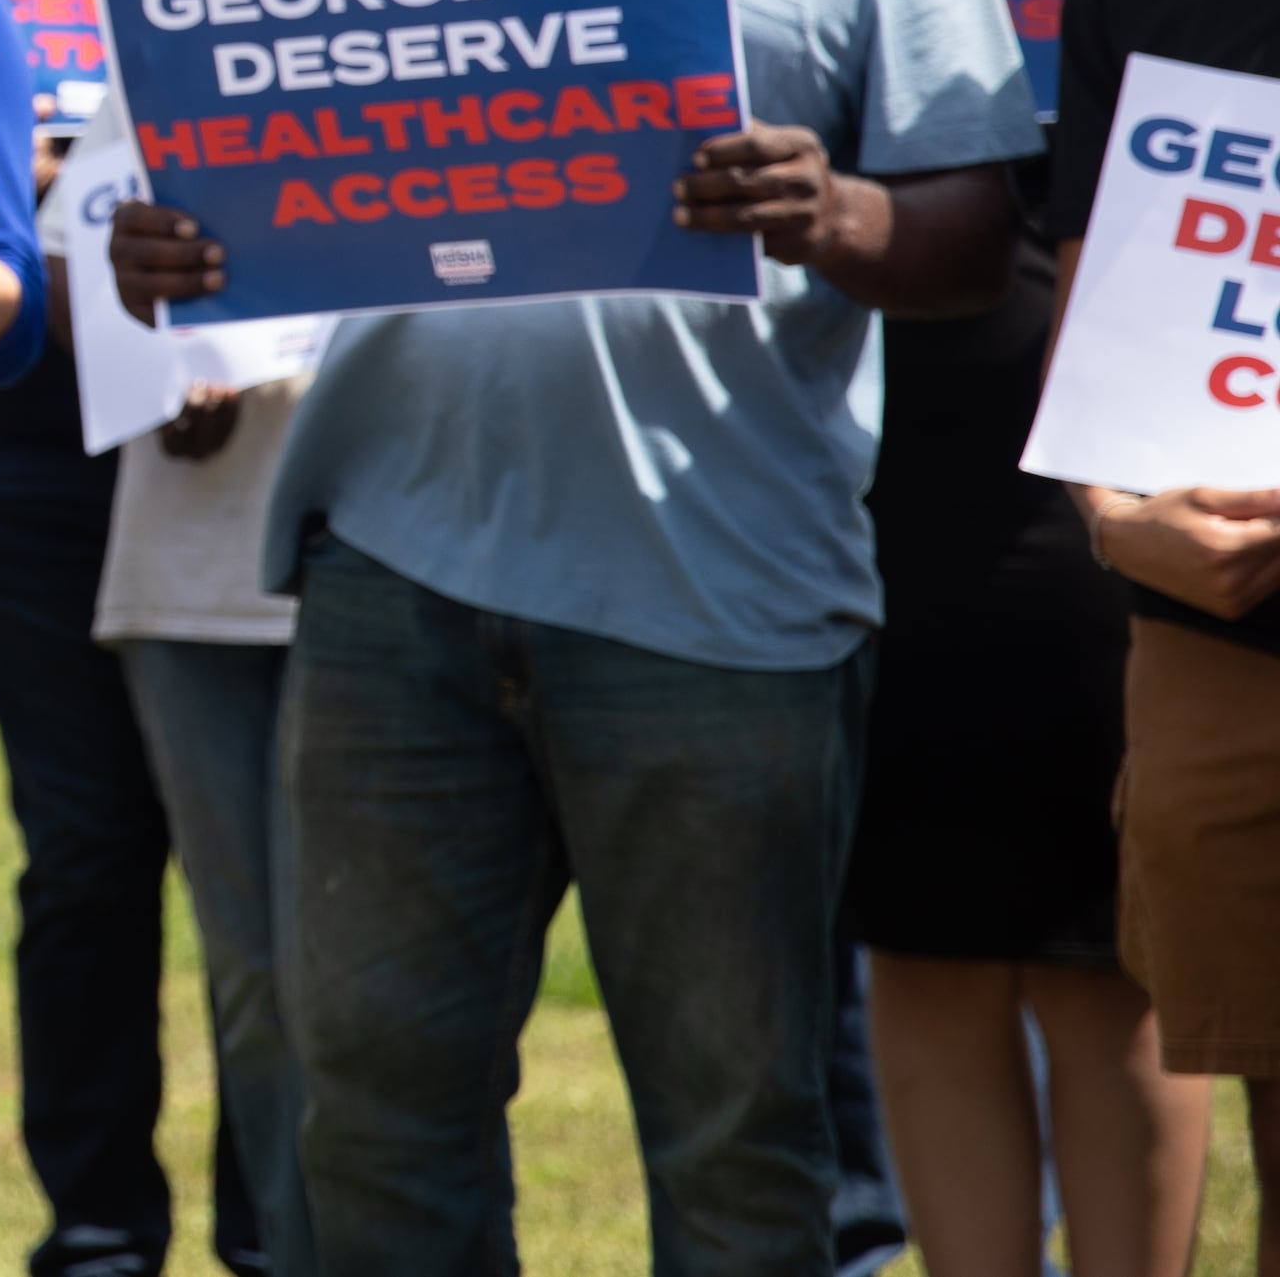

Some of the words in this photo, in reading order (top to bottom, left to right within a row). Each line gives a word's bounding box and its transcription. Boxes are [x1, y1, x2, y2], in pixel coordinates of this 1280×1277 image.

[213, 8, 628, 97] DESERVE
[137, 74, 740, 170] HEALTHCARE
[272, 154, 628, 228] ACCESS
